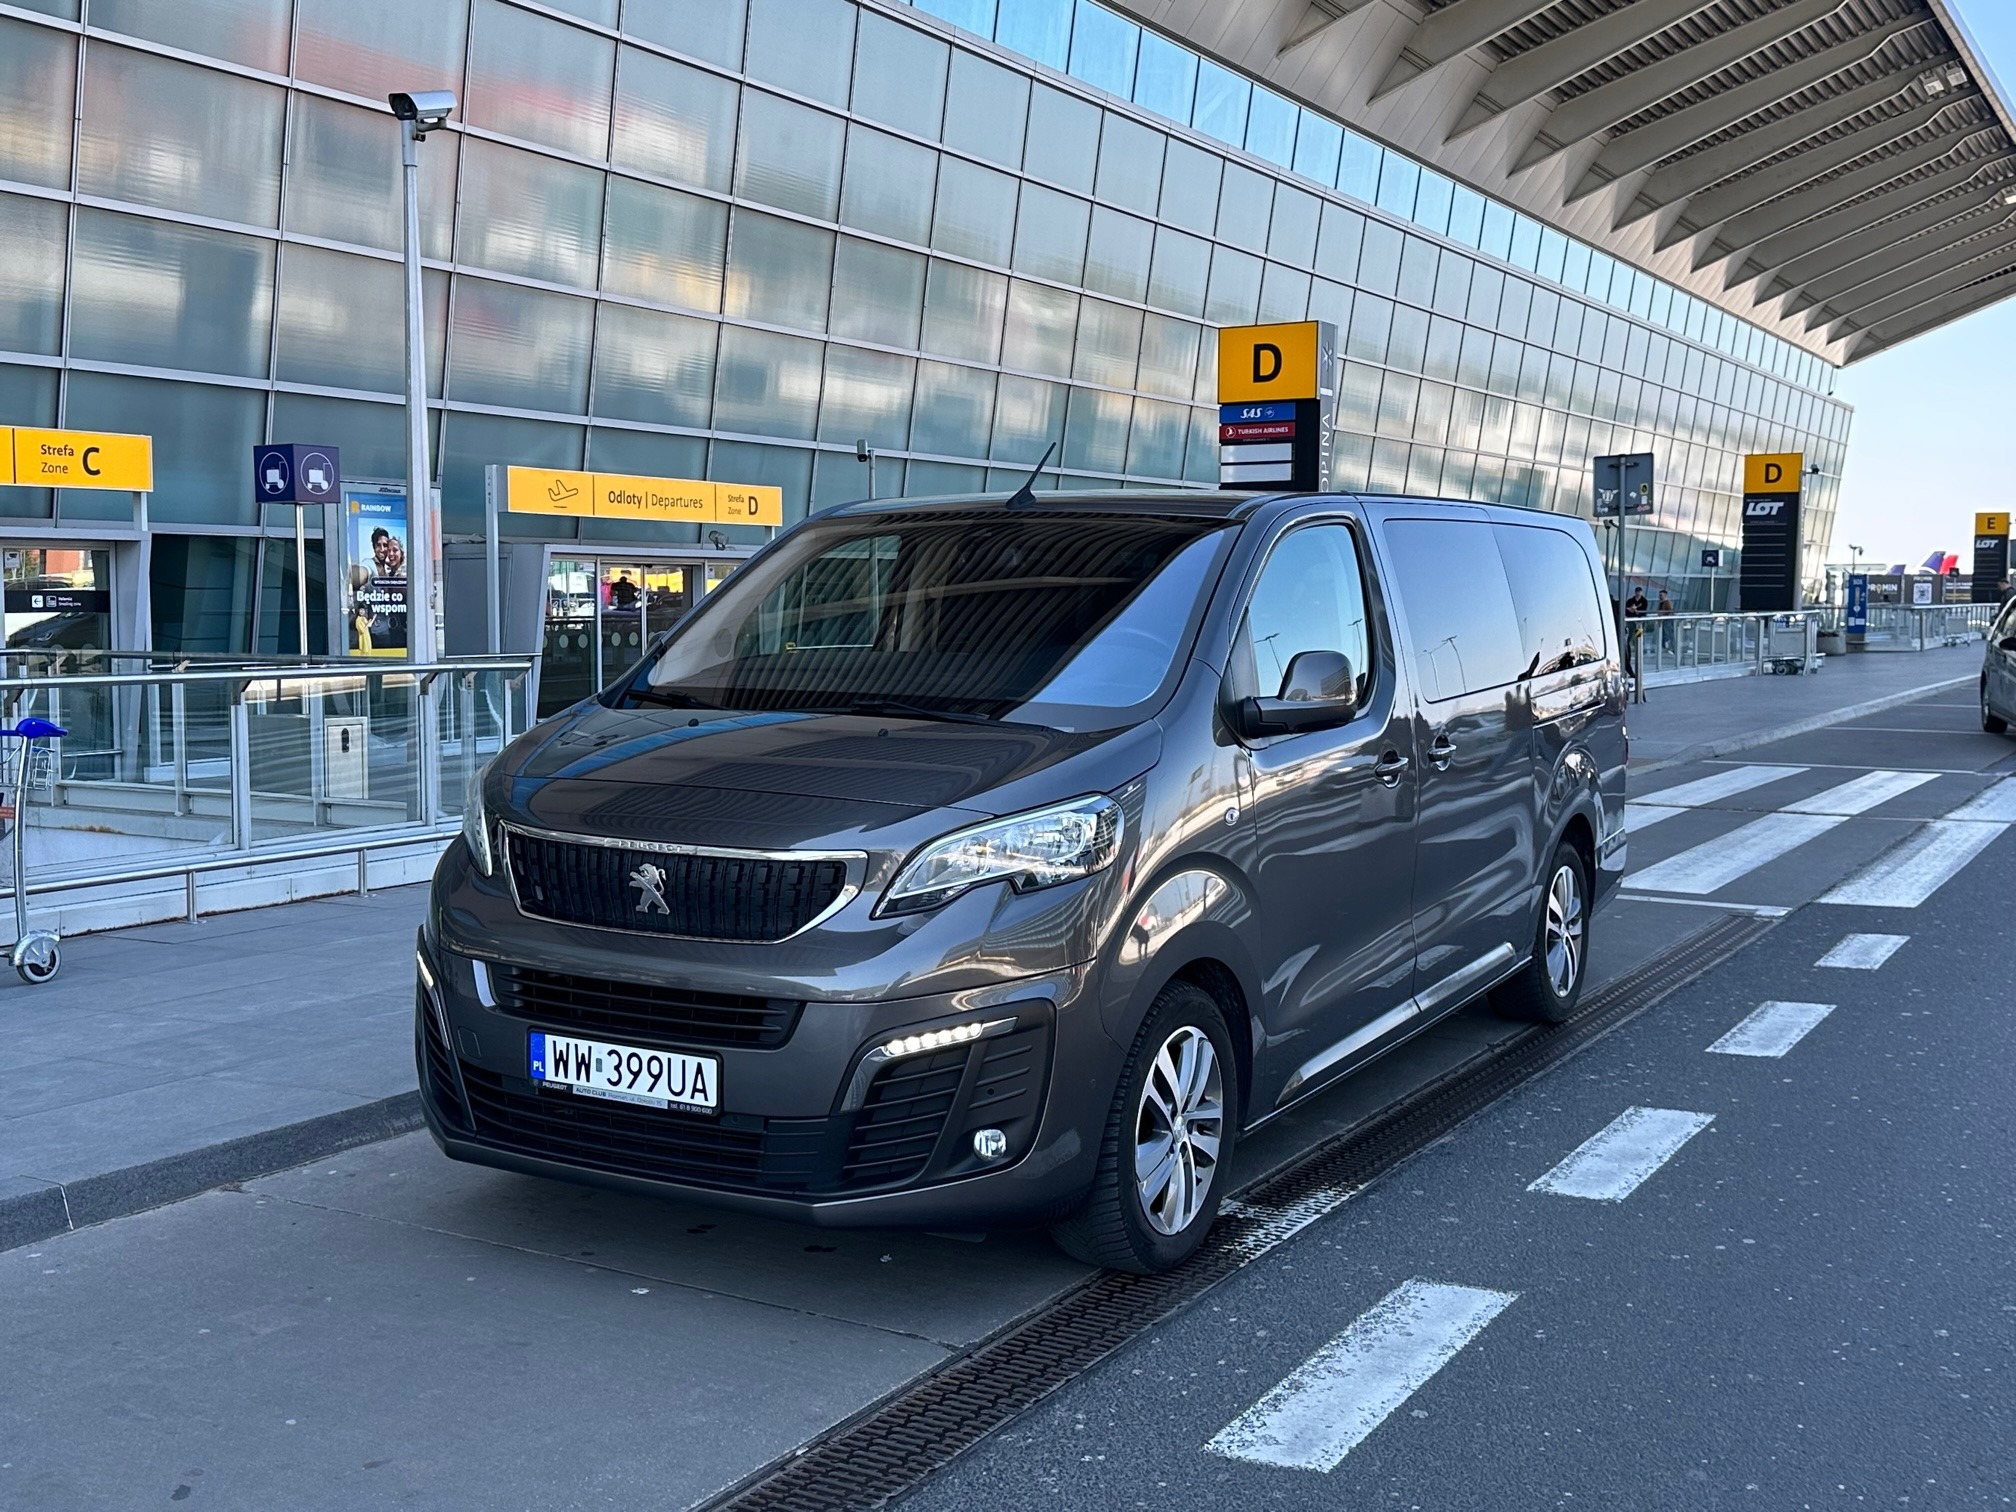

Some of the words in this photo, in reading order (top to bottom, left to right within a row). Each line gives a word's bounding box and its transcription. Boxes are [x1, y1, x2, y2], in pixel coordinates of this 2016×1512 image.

[1253, 343, 1283, 383] D
[1240, 407, 1263, 418] SAS
[1263, 426, 1289, 434] AIRLINES
[40, 443, 75, 456] Strefa
[82, 446, 101, 476] C
[41, 462, 69, 474] Zone
[1764, 463, 1782, 483] D
[608, 490, 643, 509] Odloty
[651, 493, 703, 510] Departures
[727, 494, 745, 504] Strefa
[748, 496, 759, 515] D
[361, 504, 392, 512] RAINBOW
[727, 507, 742, 515] Zone
[1745, 501, 1785, 516] LOT
[1987, 517, 1996, 530] E
[1975, 539, 1999, 548] LOT
[356, 590, 390, 604] Będzie
[391, 592, 403, 602] co
[371, 604, 407, 616] wspom
[620, 840, 683, 852] PEUGEOT
[533, 1060, 544, 1072] PL
[552, 1040, 592, 1083] WW
[606, 1049, 709, 1102] 399UA
[542, 1081, 567, 1091] PEUGEOT
[576, 1087, 591, 1095] AUTO
[592, 1089, 607, 1097] CLUB
